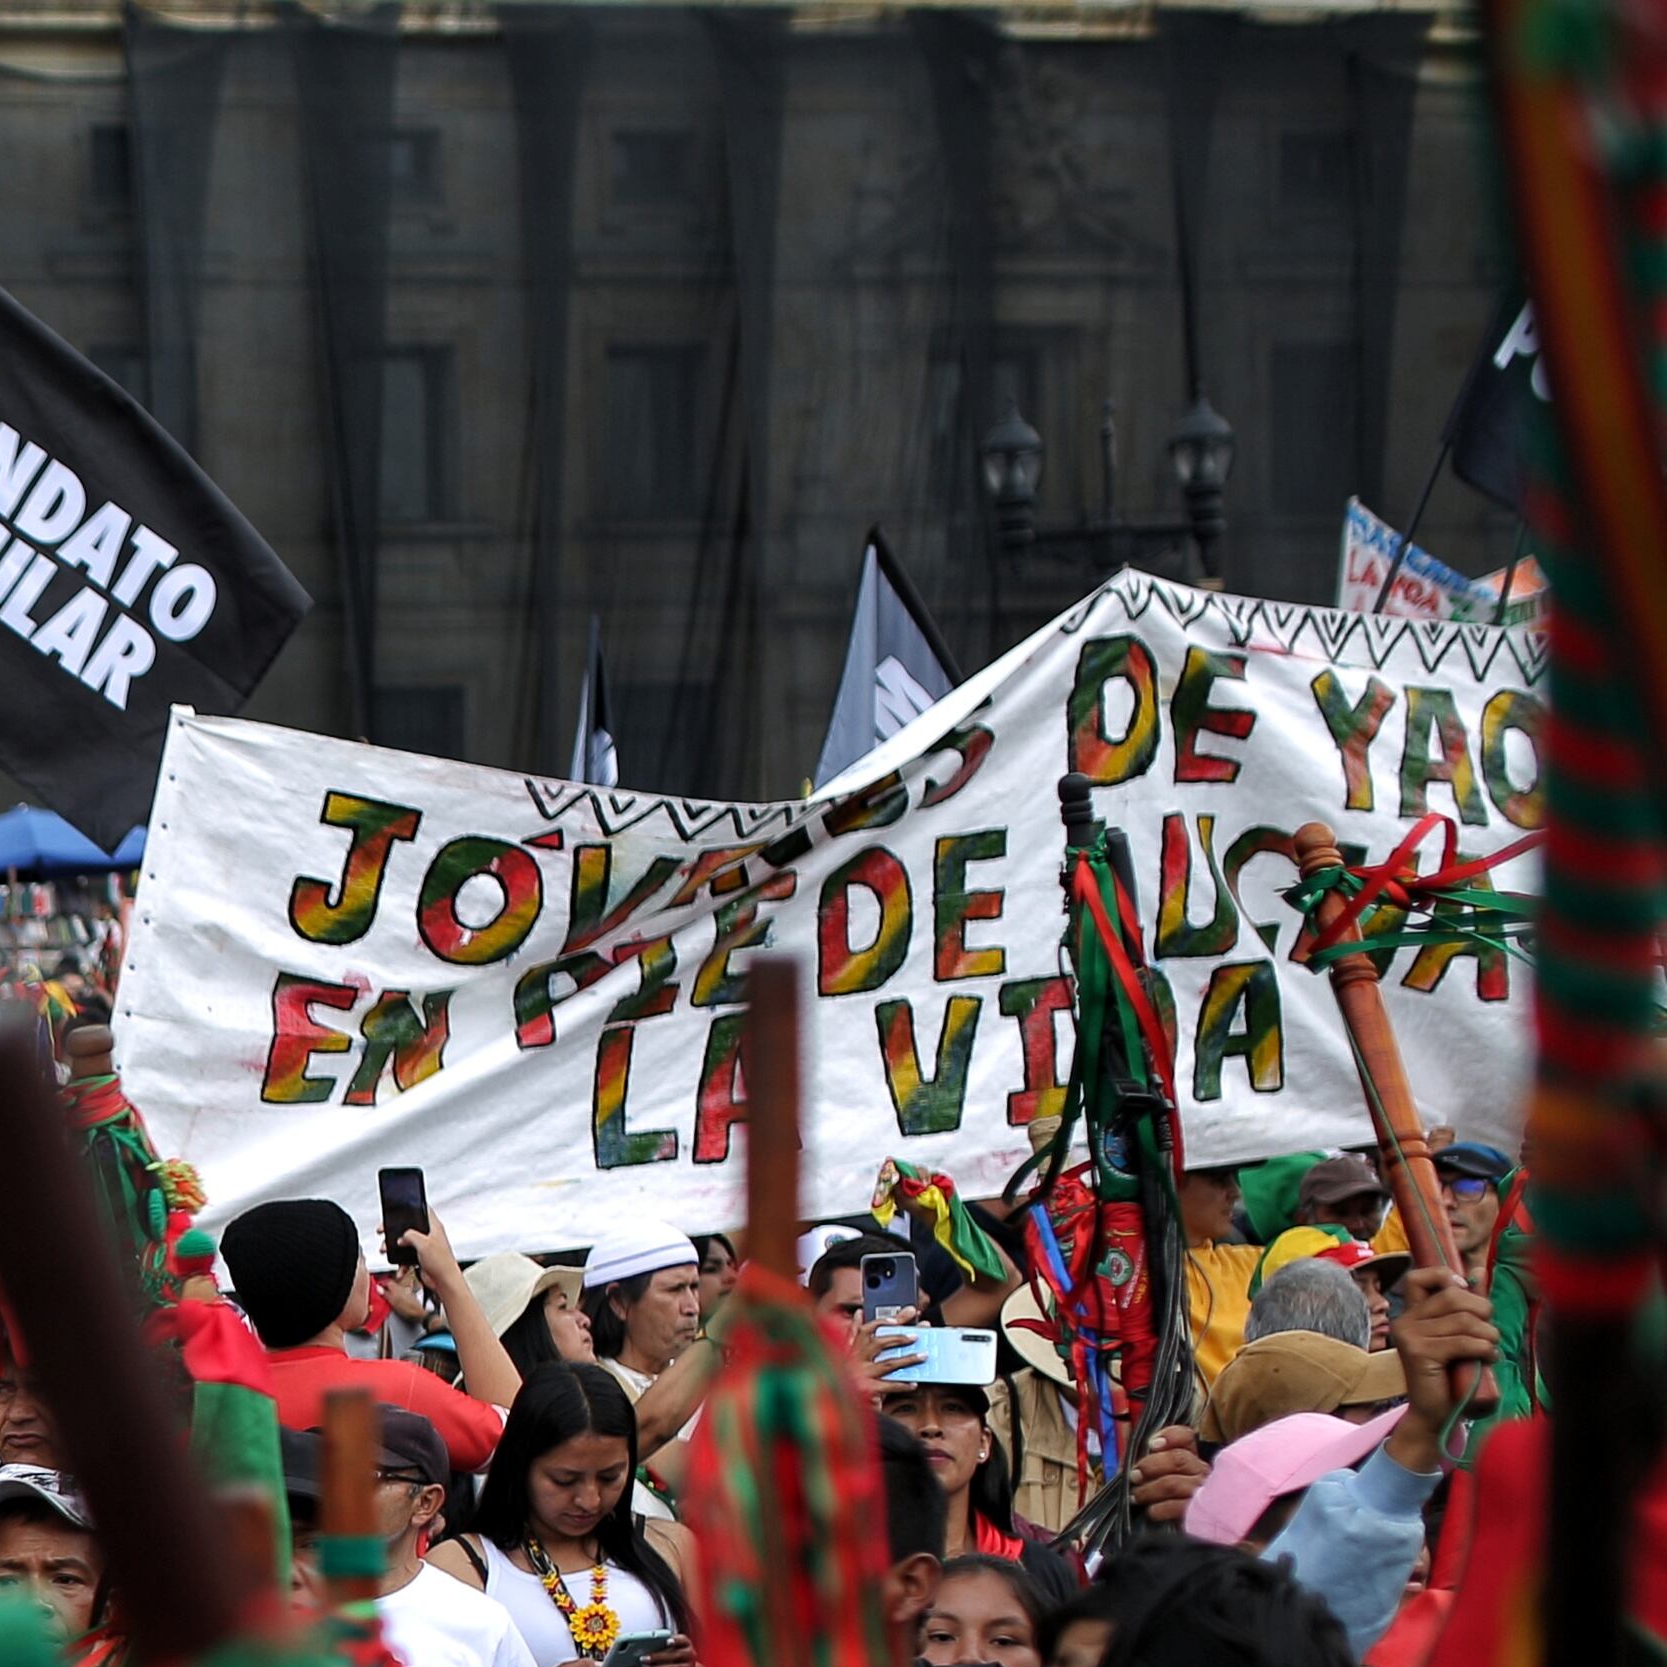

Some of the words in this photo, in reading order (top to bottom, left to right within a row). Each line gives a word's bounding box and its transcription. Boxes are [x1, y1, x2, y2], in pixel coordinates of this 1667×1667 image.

[289, 695, 995, 966] JÓVS
[1067, 634, 1256, 787] DE
[262, 972, 453, 1107] EN
[818, 827, 1007, 997] DE
[1154, 811, 1509, 1001] UCA
[876, 961, 1284, 1136] VIA
